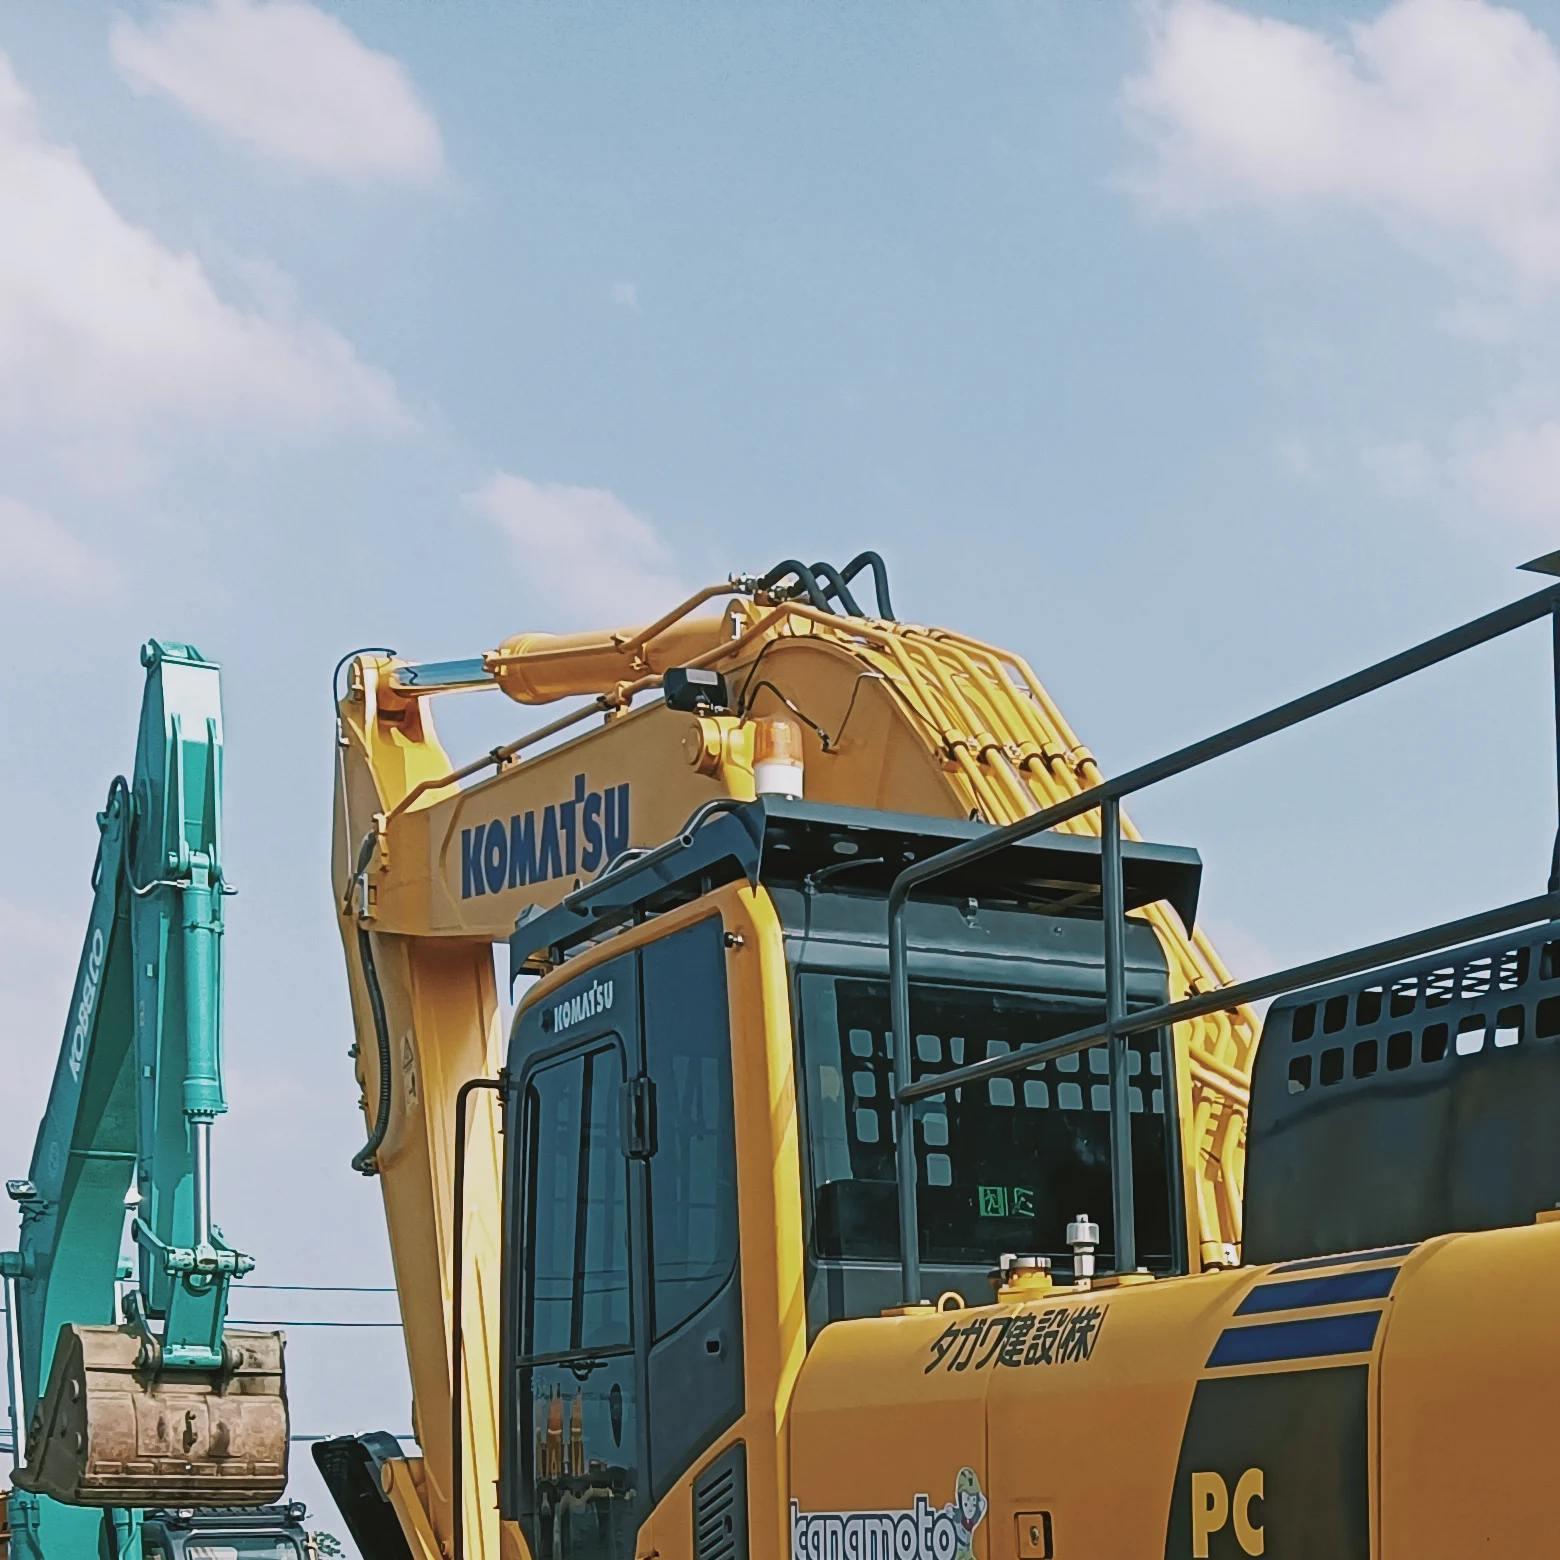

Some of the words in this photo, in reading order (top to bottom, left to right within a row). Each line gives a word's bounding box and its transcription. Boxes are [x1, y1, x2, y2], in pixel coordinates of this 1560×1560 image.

[461, 773, 630, 899] KOMATSU
[69, 928, 104, 1083] KOBELCO
[554, 980, 613, 1033] KOMATSU
[1191, 1467, 1264, 1559] PC
